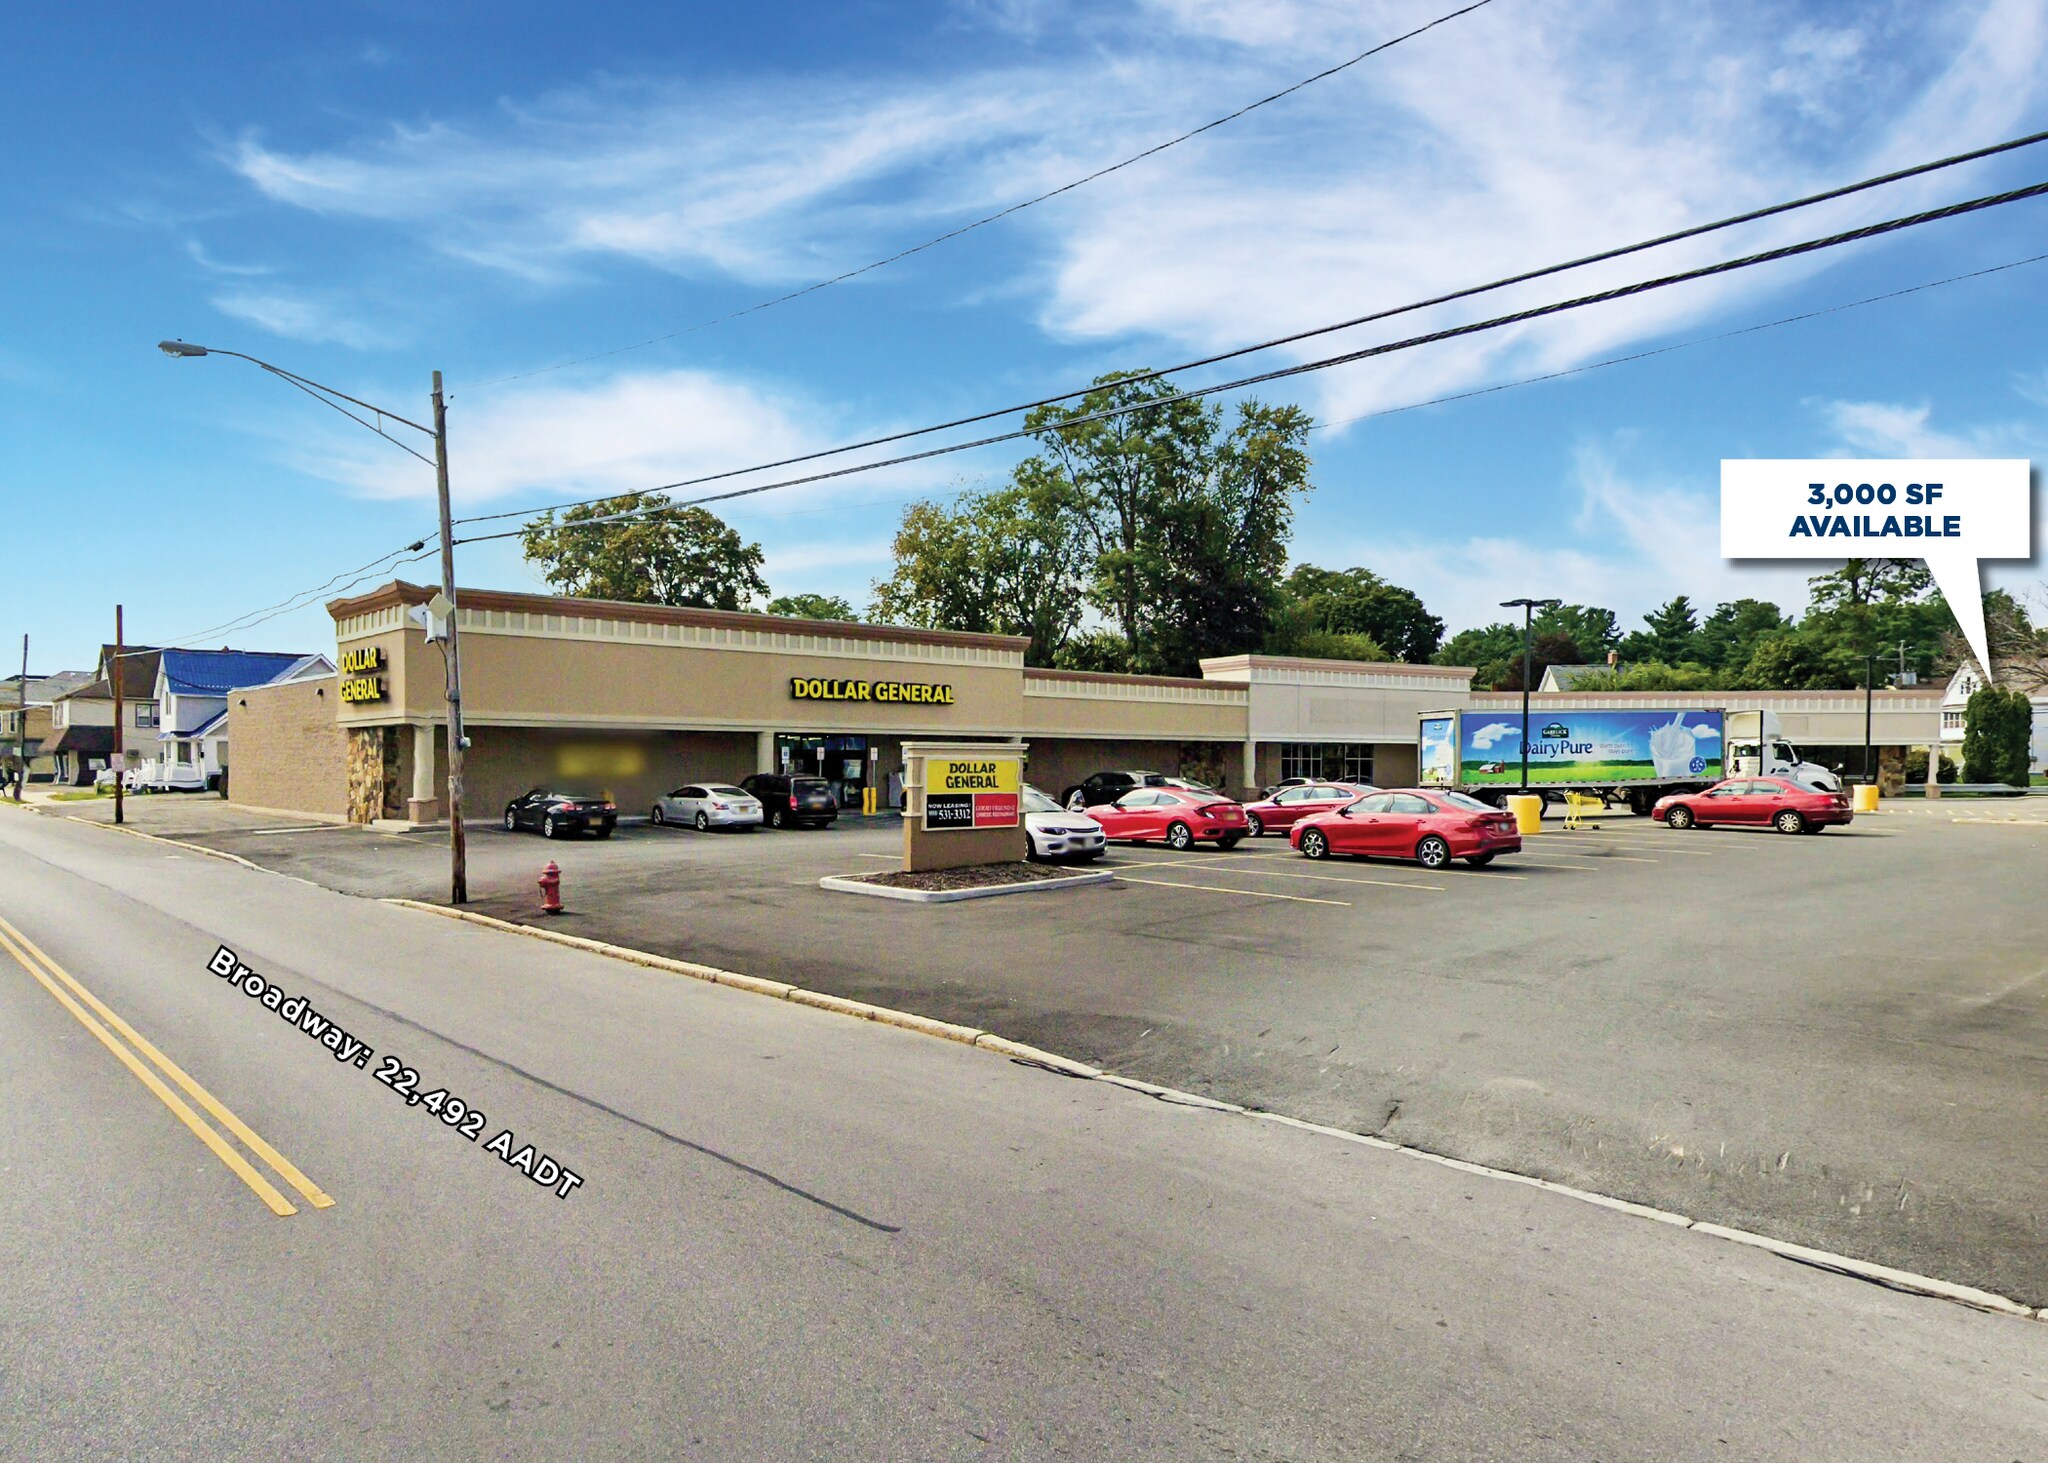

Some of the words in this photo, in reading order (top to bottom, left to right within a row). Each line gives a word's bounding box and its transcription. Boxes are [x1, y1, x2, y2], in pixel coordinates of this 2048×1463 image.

[342, 647, 378, 673] DOLLAR
[339, 677, 381, 702] GENERAL
[792, 678, 871, 701] DOLLAR
[875, 682, 955, 704] GENERAL
[949, 763, 997, 774] DOLLAR
[945, 775, 1000, 789] GENERAL
[938, 809, 971, 820] 531-3312
